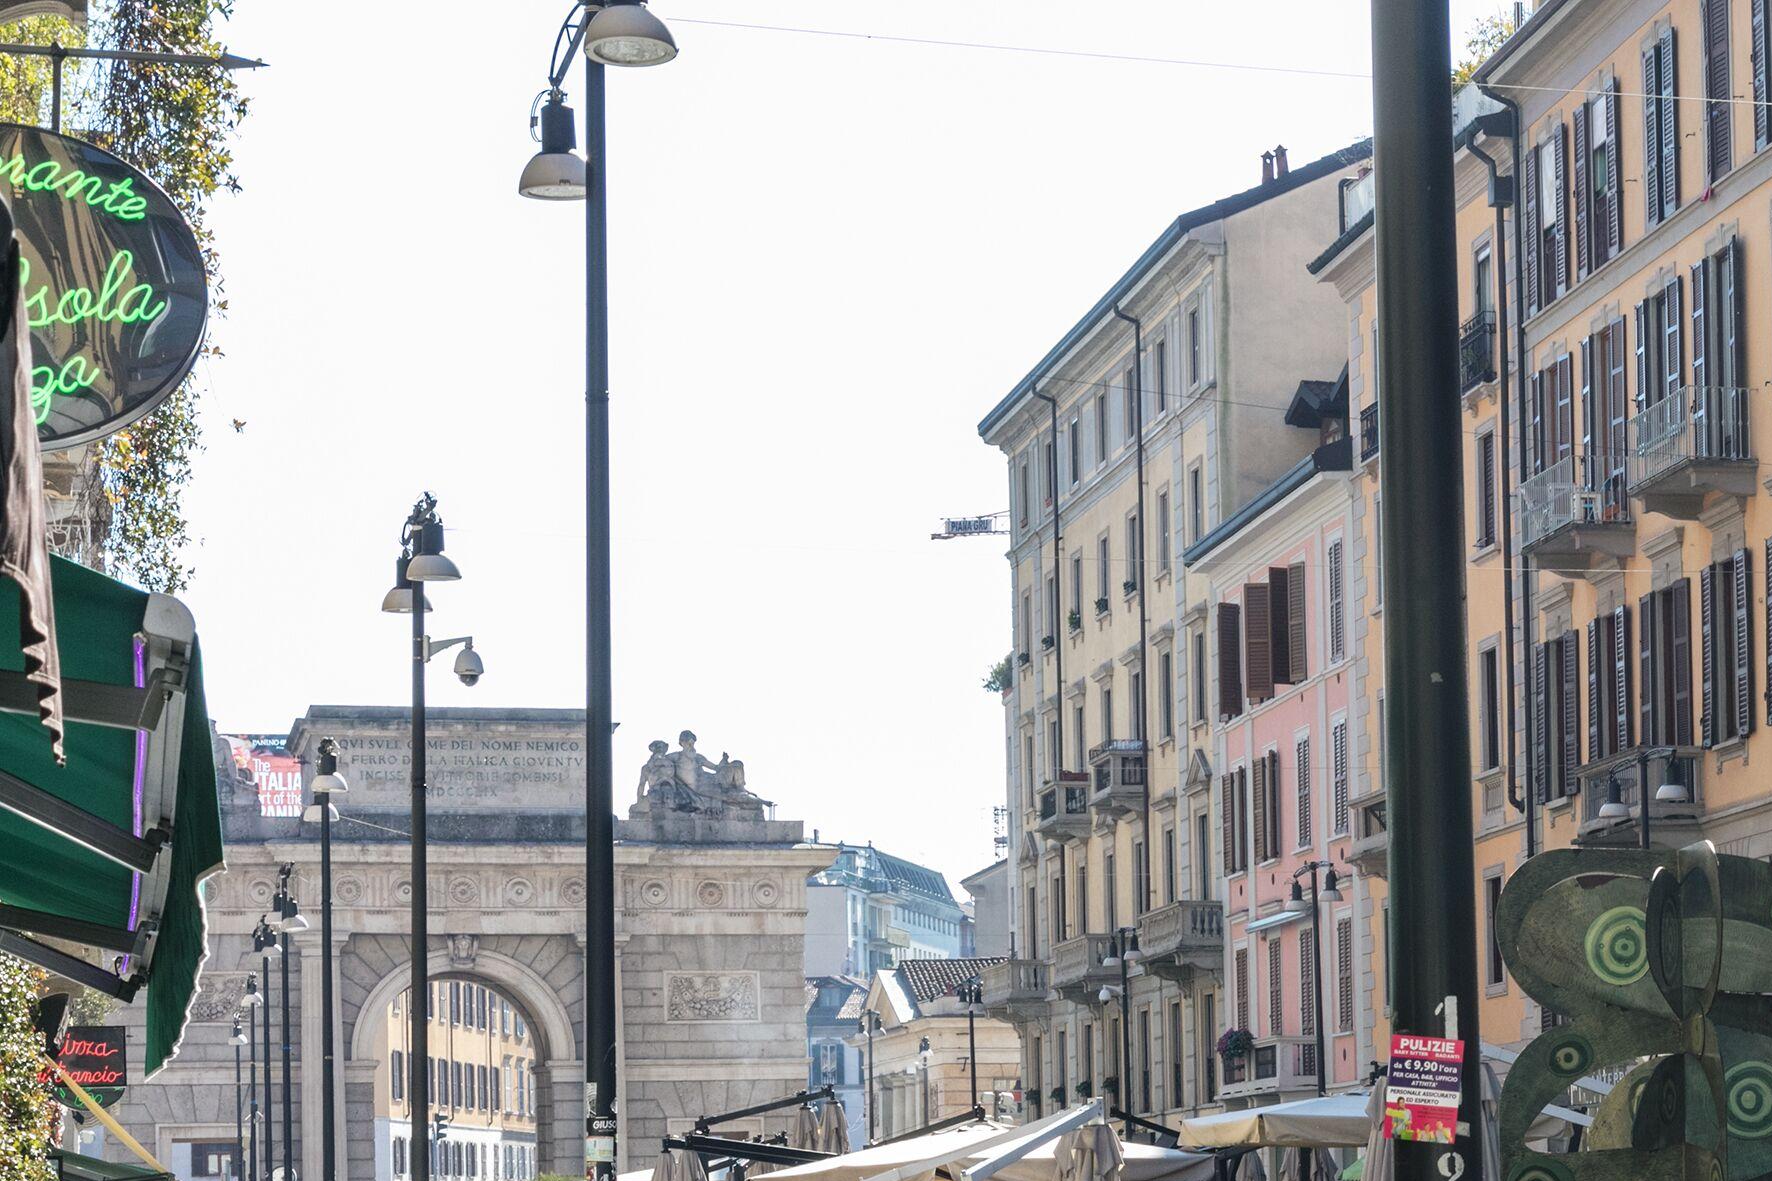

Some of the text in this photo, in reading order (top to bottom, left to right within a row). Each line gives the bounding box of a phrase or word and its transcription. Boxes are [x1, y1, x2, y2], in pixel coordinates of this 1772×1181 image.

[481, 741, 522, 752] NOME
[526, 741, 580, 752] NEMICO
[254, 758, 271, 773] The
[351, 755, 398, 767] FERRO
[1400, 1038, 1456, 1054] PULIZIE
[1393, 1061, 1403, 1069] da
[1413, 1060, 1438, 1072] 9,90
